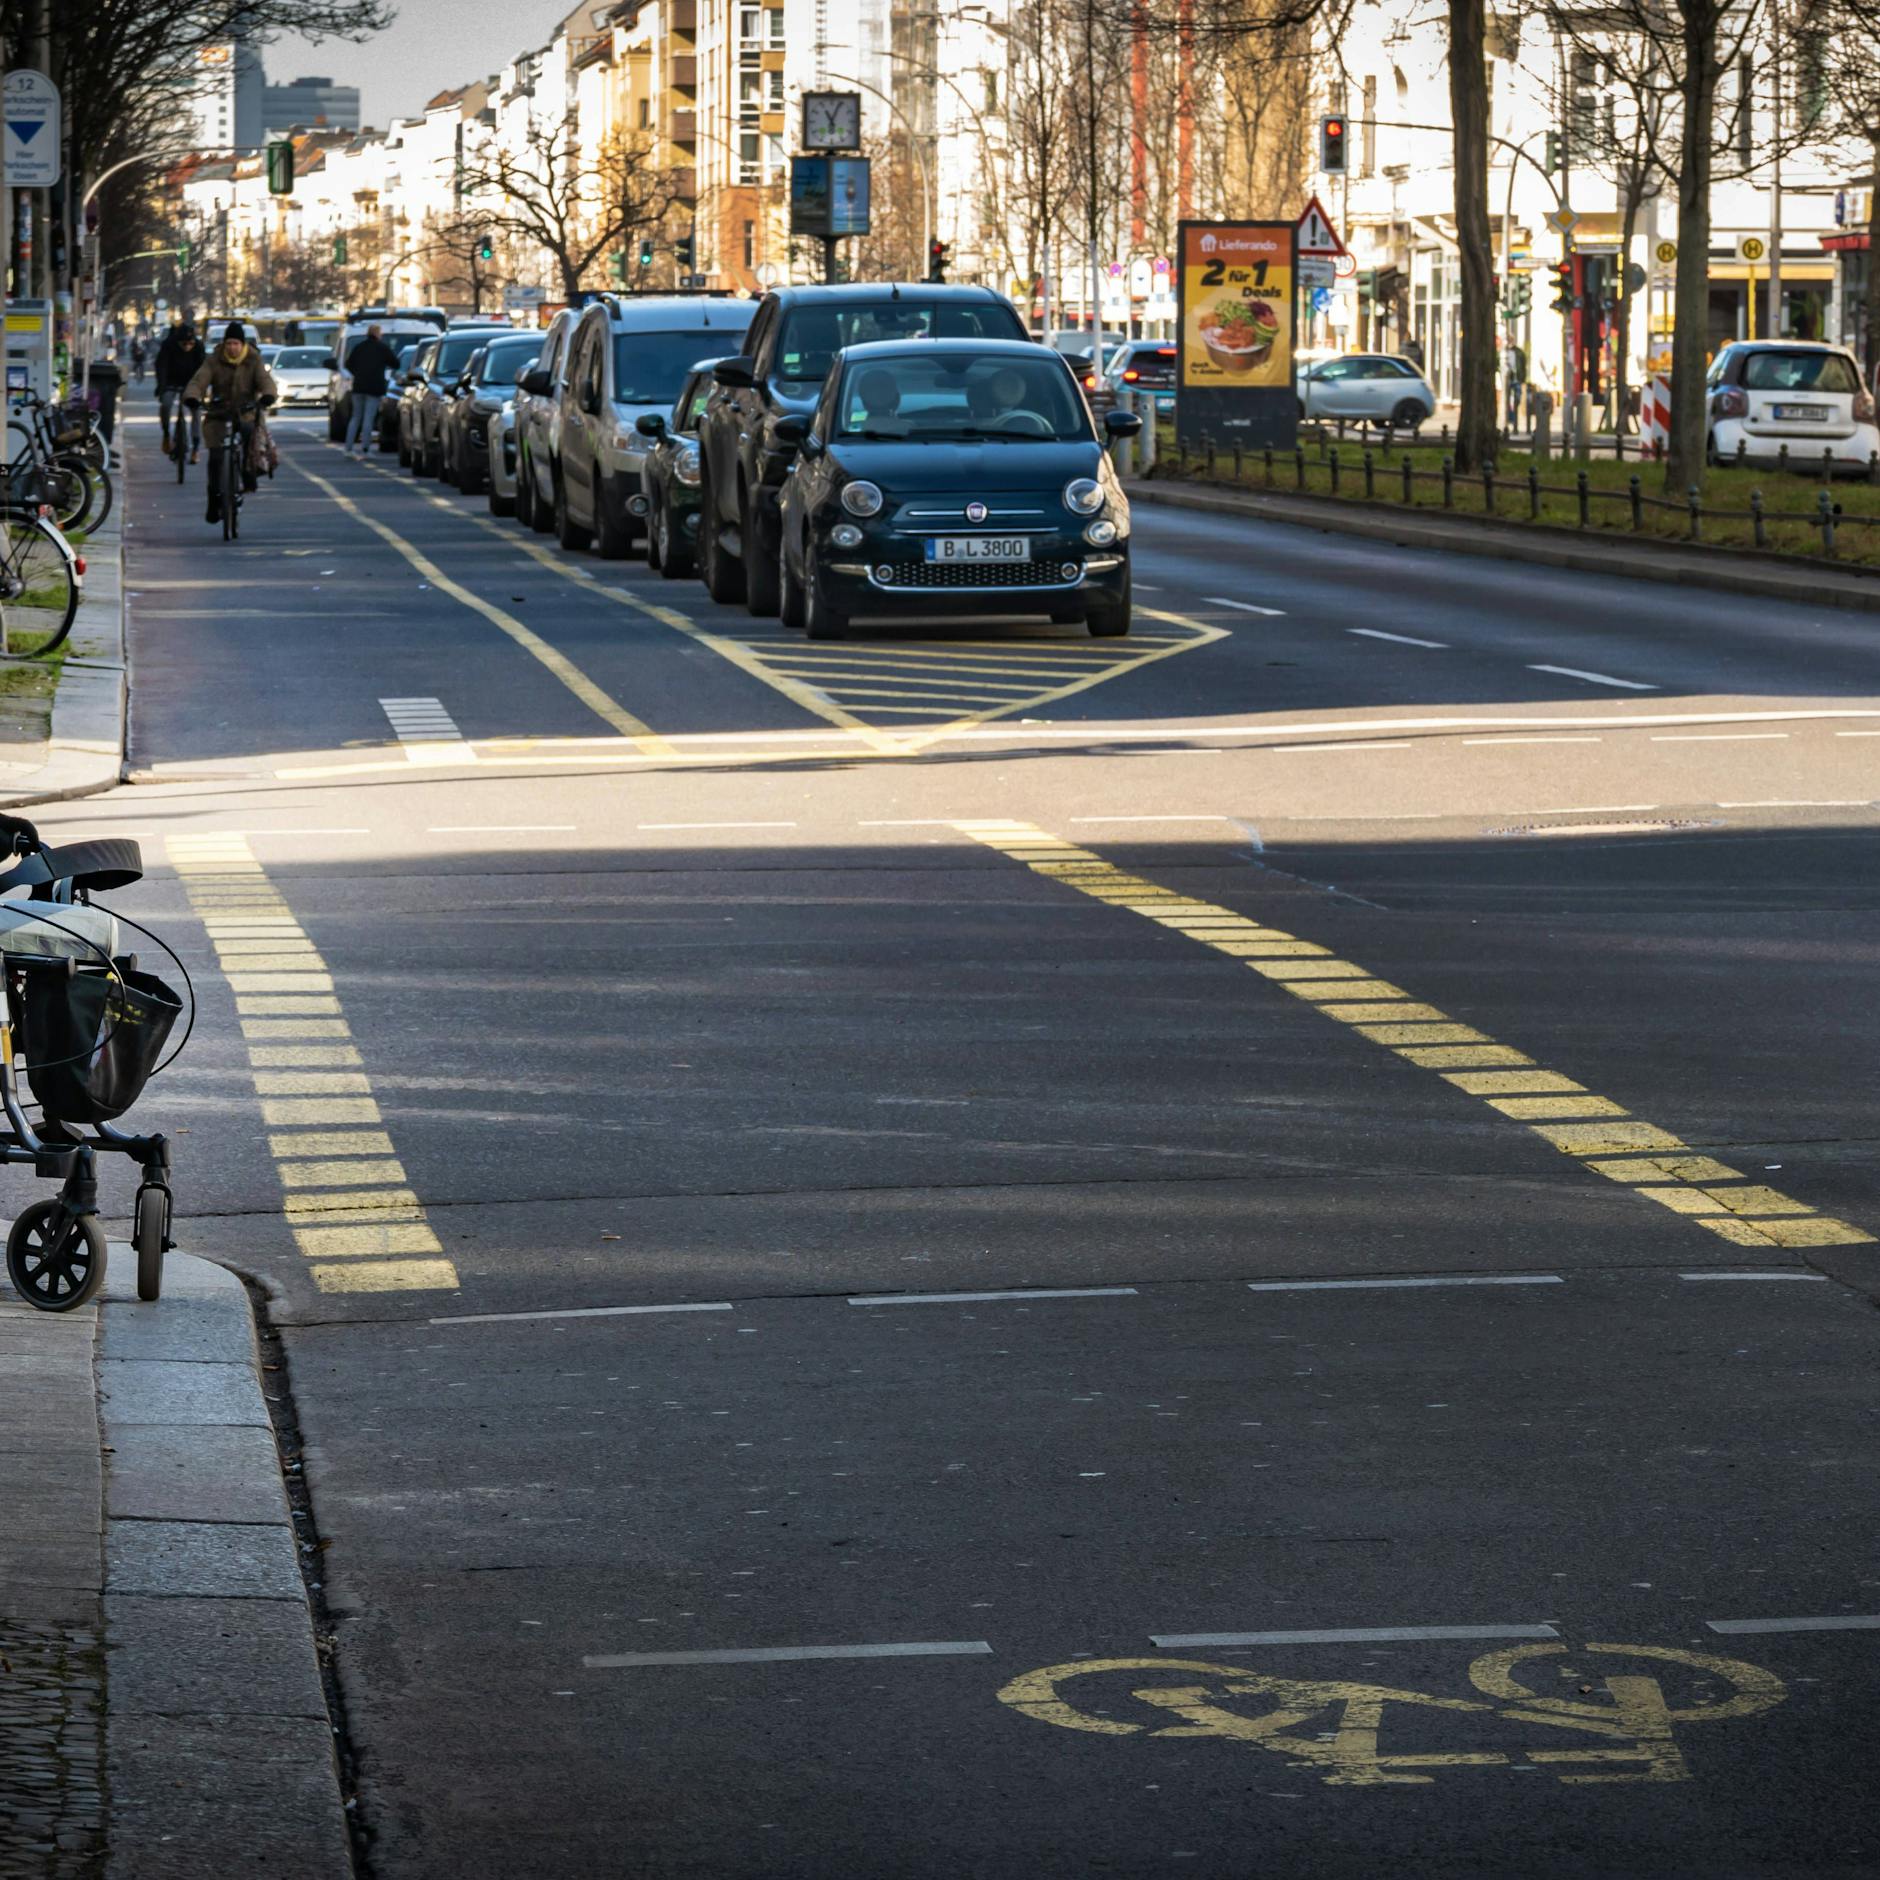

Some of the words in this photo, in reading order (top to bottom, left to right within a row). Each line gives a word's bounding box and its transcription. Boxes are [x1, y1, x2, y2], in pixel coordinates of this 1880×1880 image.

[18, 78, 34, 90] 12
[1219, 239, 1278, 251] Lieferando
[1200, 258, 1226, 287] 2
[1228, 270, 1251, 282] für
[1252, 259, 1269, 286] 1
[1242, 286, 1282, 298] Deals
[944, 540, 954, 557] B
[981, 540, 1023, 557] 3800
